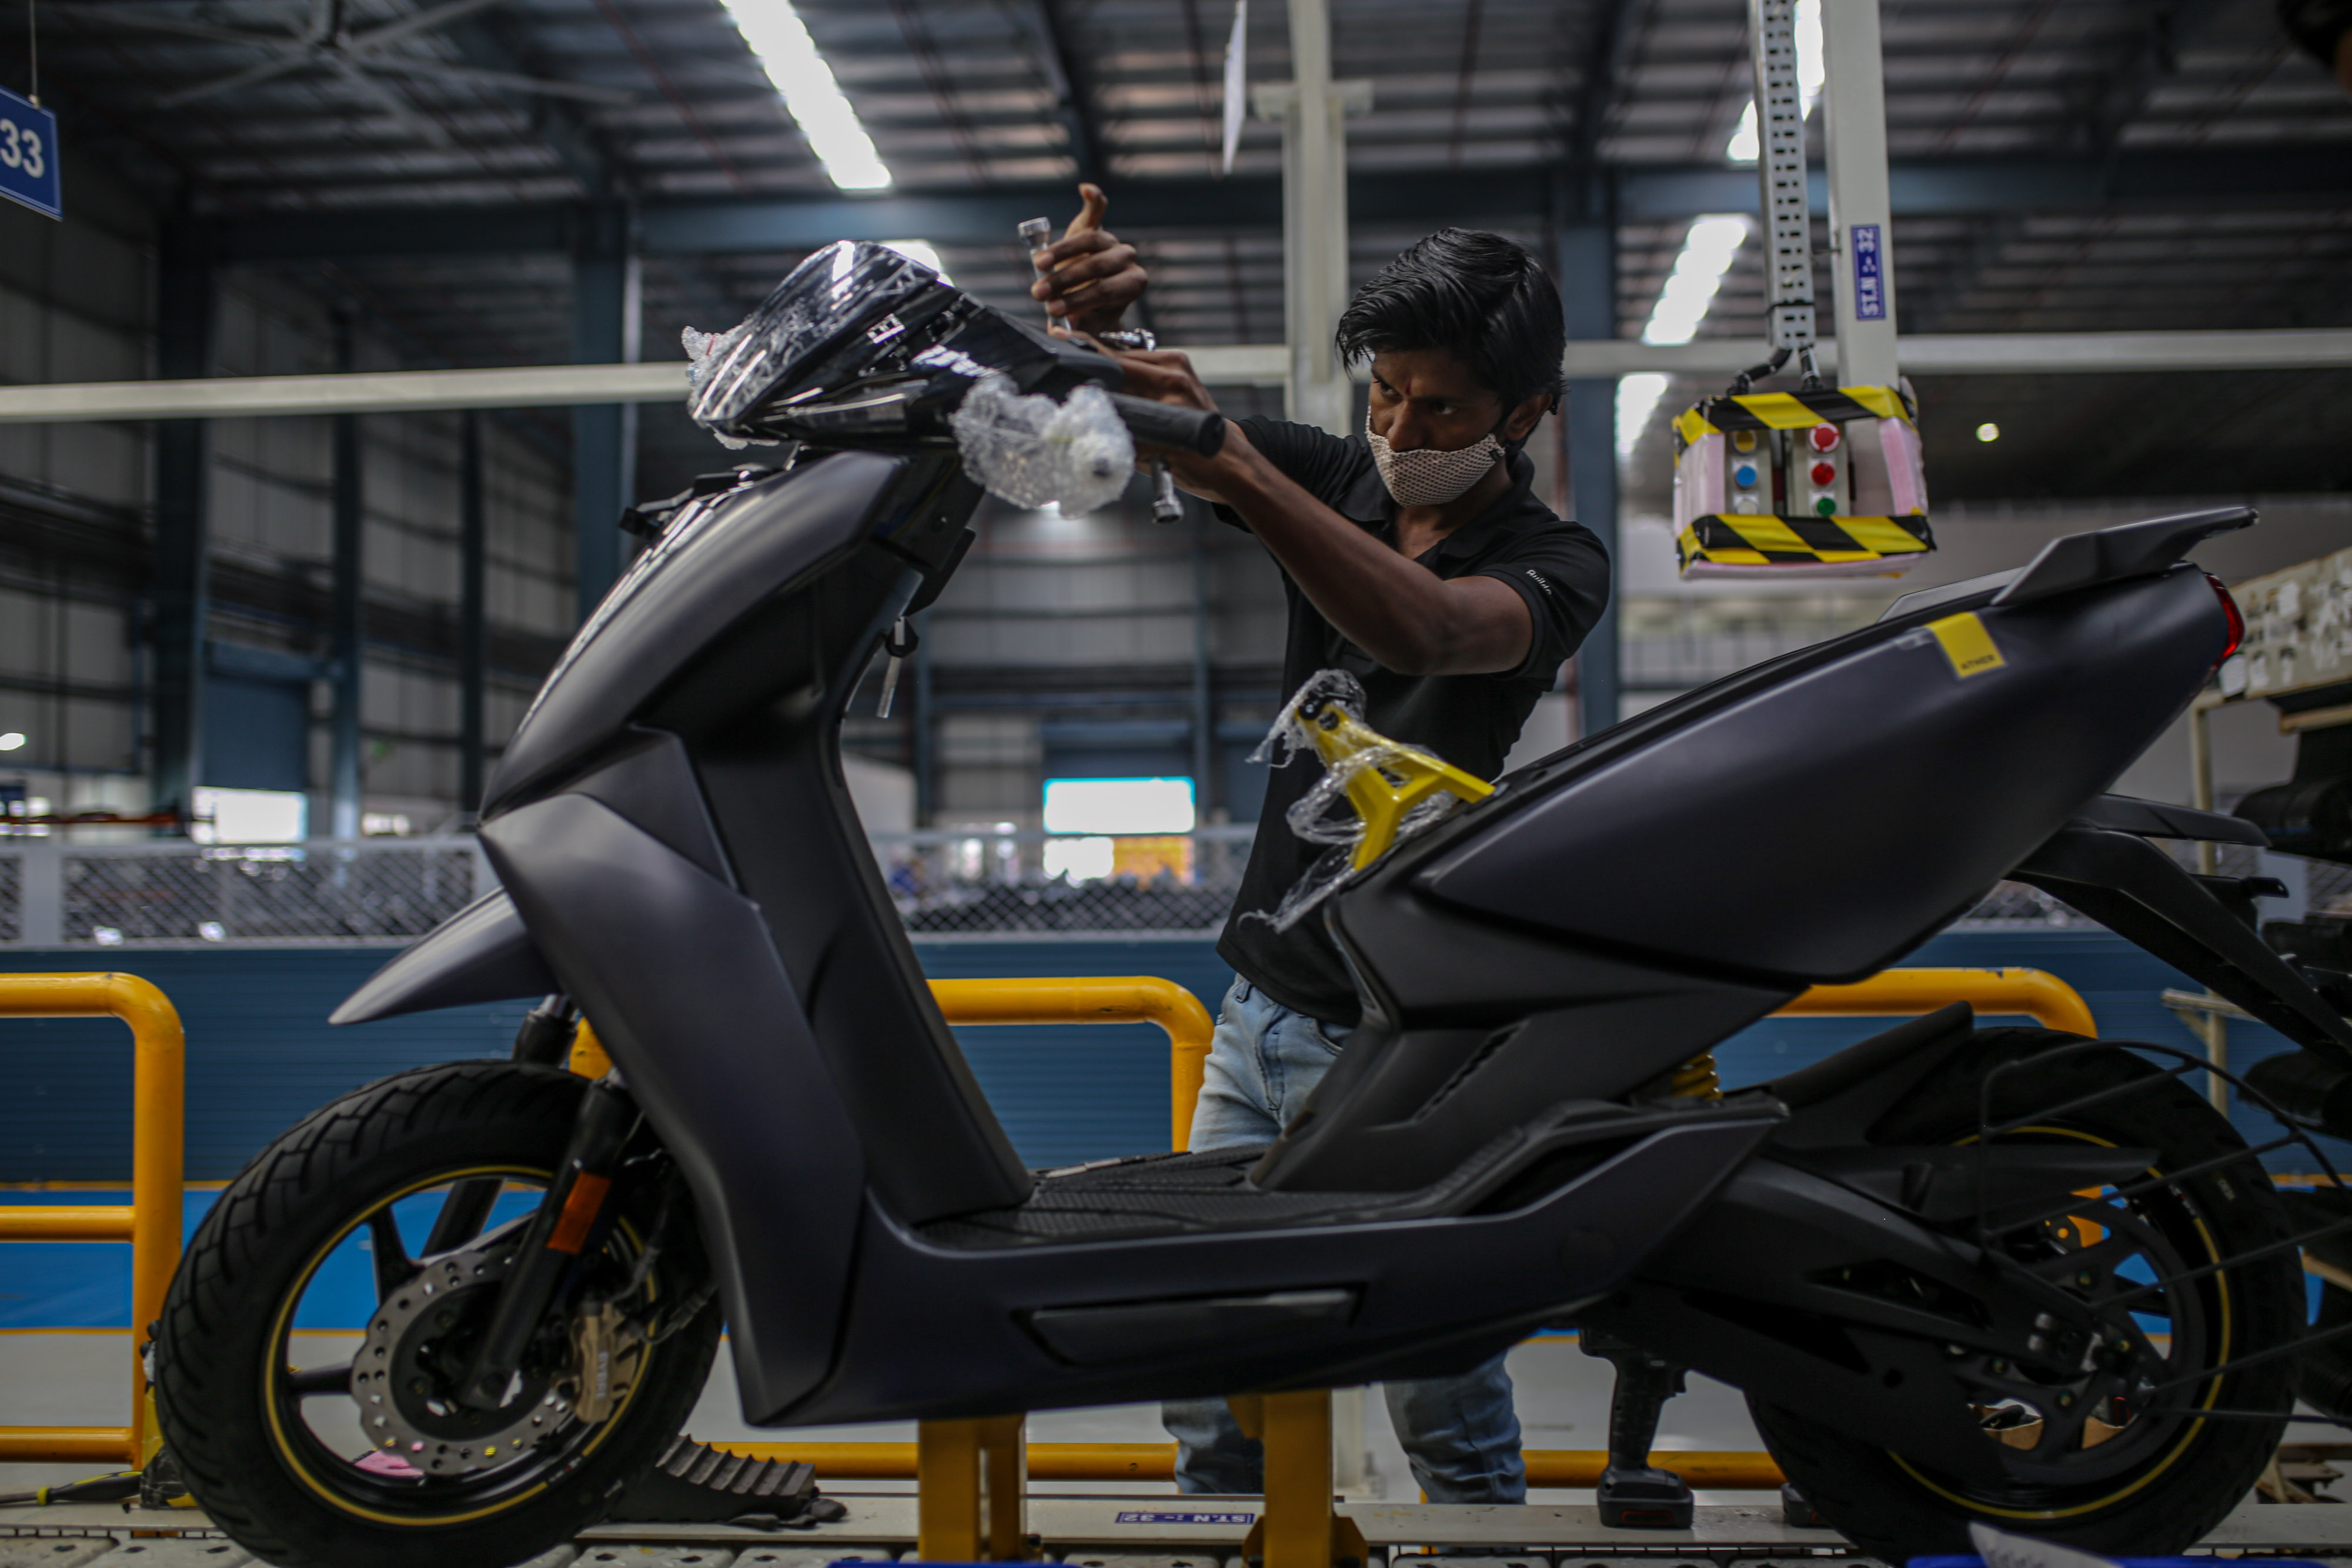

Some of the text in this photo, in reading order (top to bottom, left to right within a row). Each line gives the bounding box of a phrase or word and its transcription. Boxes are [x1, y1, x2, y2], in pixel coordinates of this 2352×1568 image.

[0, 118, 45, 178] 33
[1857, 228, 1876, 253] 32
[1123, 1514, 1156, 1522] 32
[1192, 1513, 1247, 1523] ST.N
